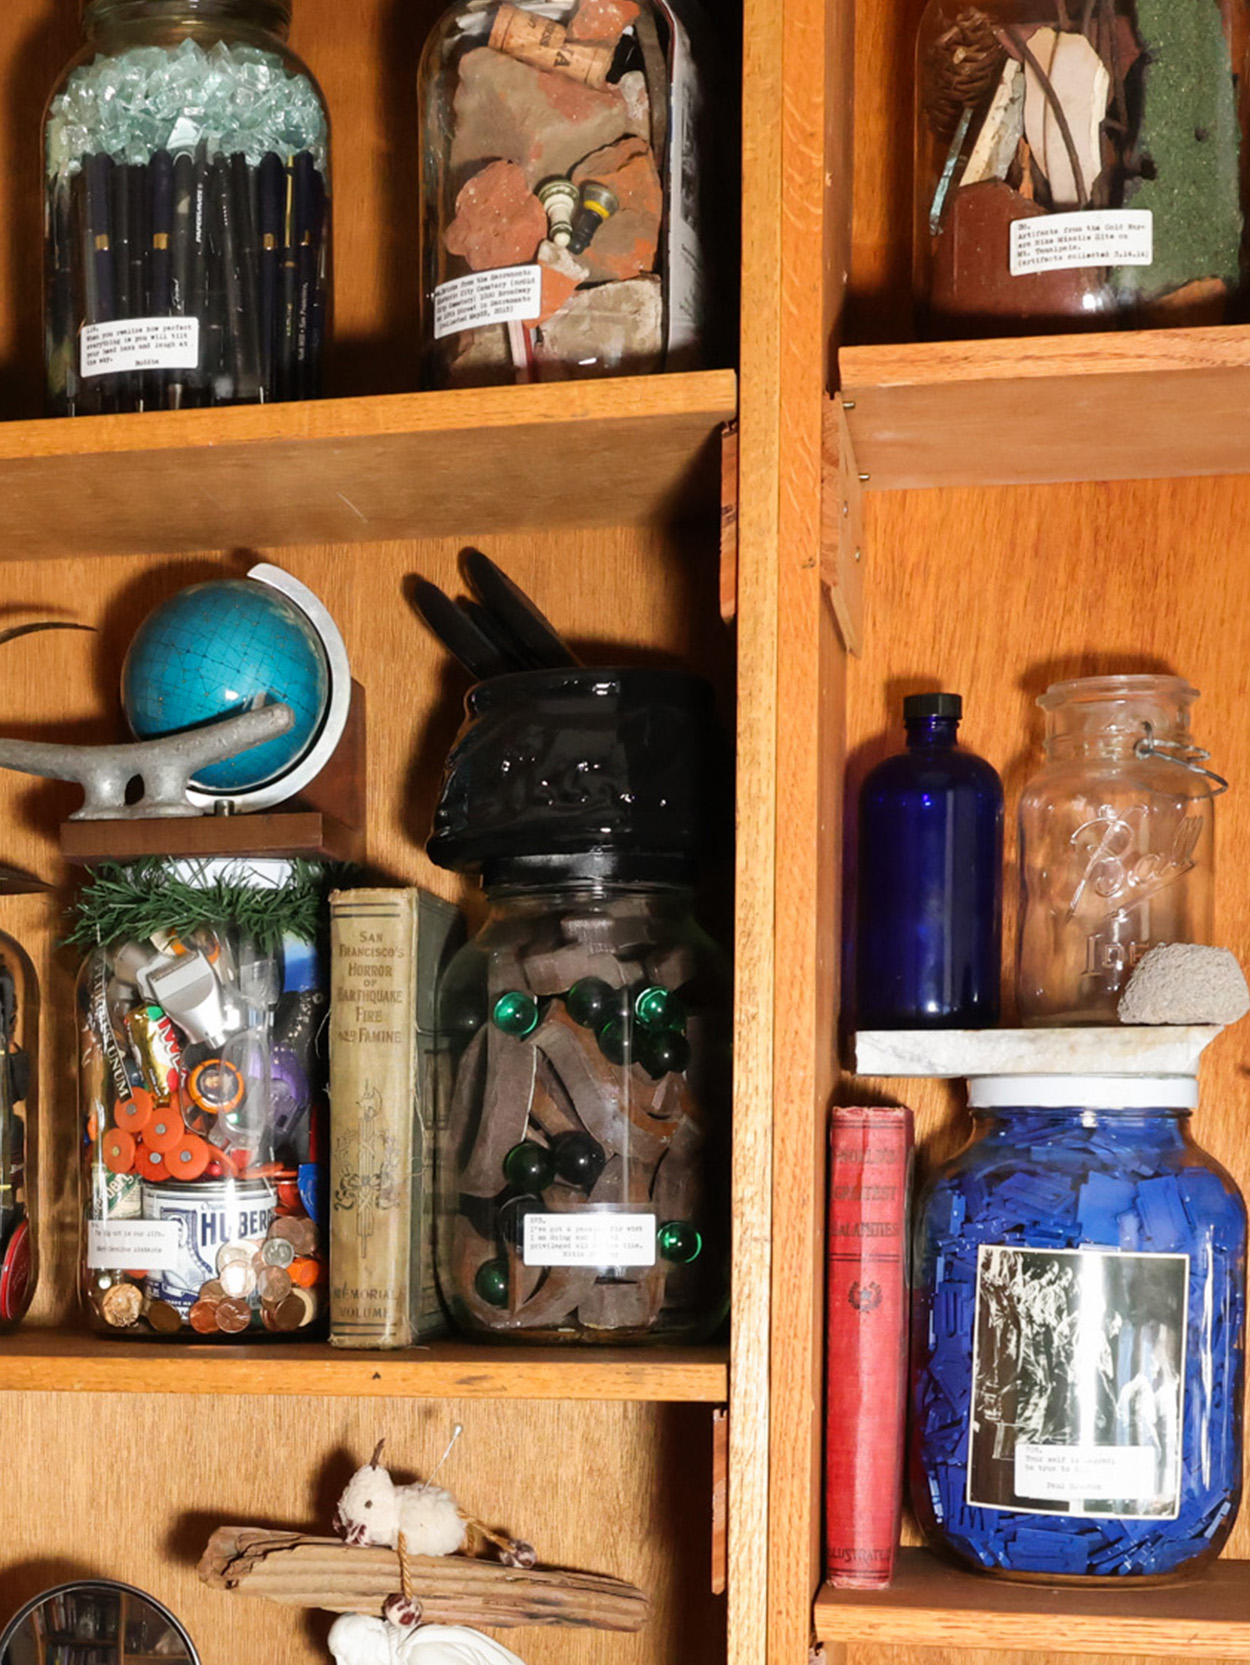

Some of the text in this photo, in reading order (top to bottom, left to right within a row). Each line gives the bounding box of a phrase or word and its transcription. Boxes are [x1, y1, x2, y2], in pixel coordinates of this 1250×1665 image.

[1018, 229, 1058, 239] Artifacts
[1058, 235, 1091, 243] Missile
[359, 931, 383, 942] SAN
[339, 944, 404, 958] FRANCISCO'S
[1081, 932, 1150, 978] IDE
[348, 963, 393, 977] HORROR
[363, 979, 377, 987] OF
[337, 987, 403, 1004] EARTHQUAKE
[355, 1006, 382, 1023] FIRE
[358, 1028, 402, 1043] FAMINE
[106, 1048, 129, 1098] UNUM
[833, 1222, 899, 1237] ALAMITIES
